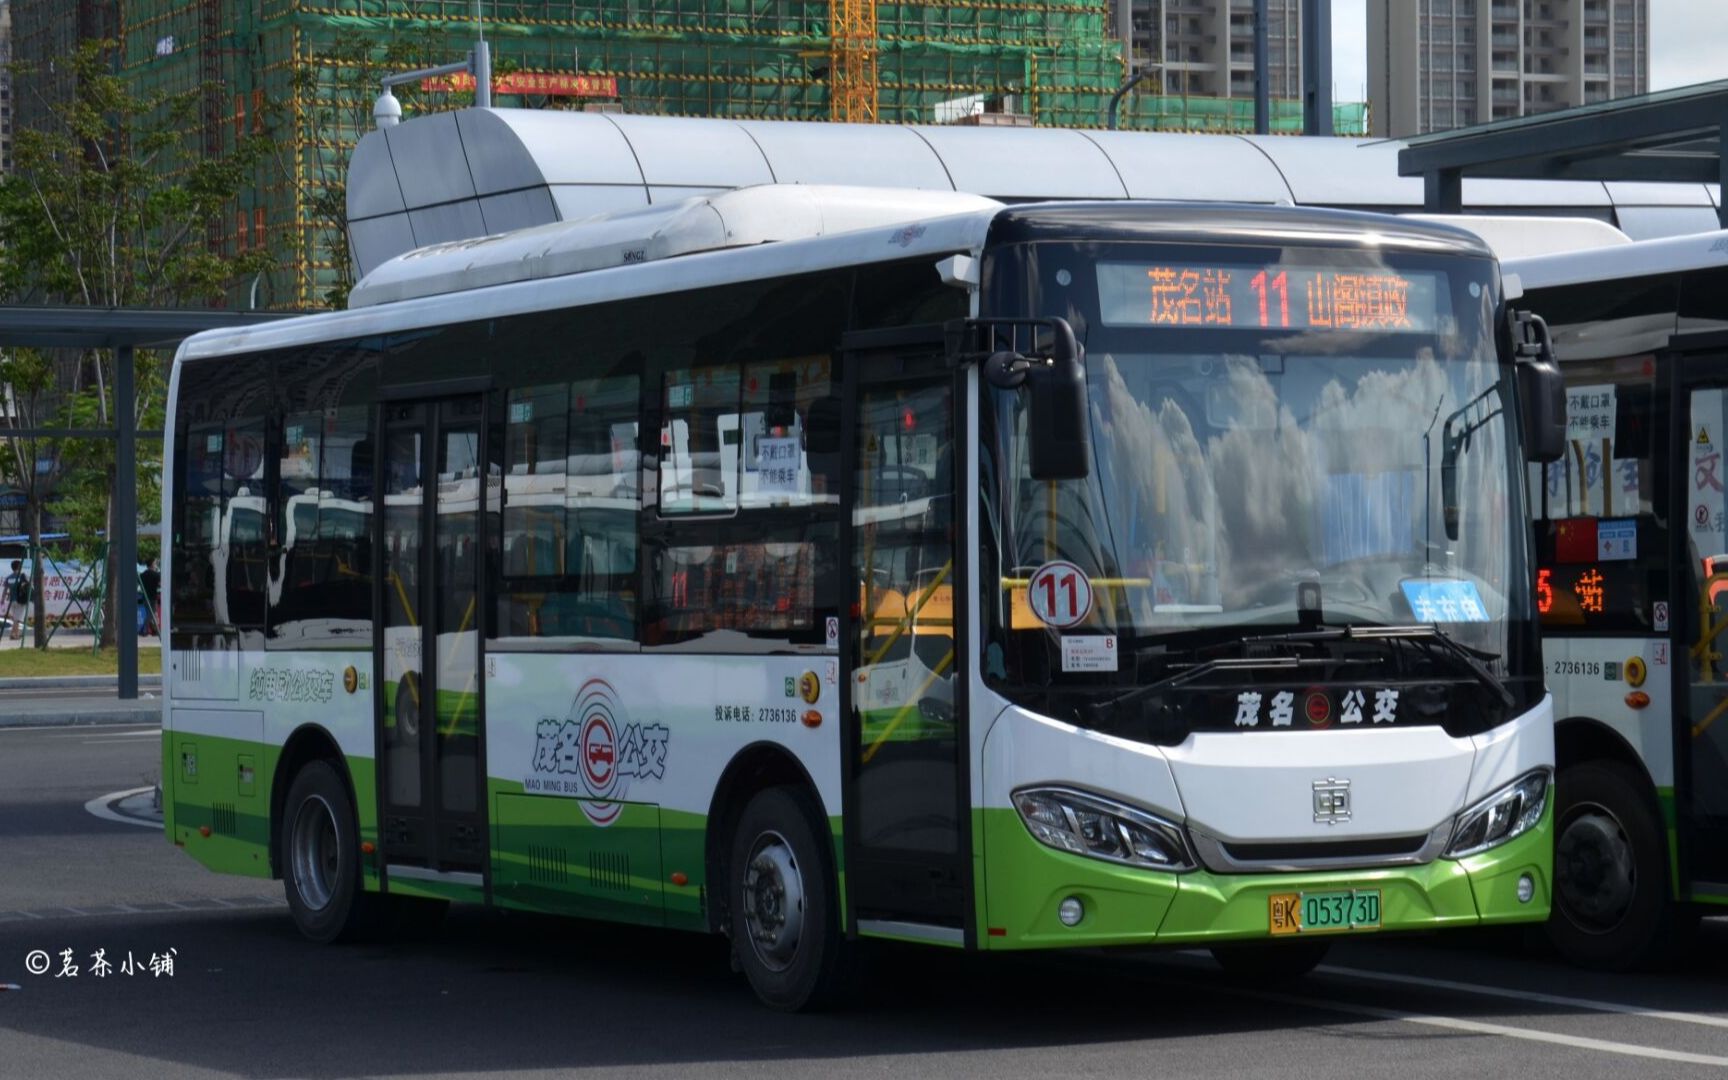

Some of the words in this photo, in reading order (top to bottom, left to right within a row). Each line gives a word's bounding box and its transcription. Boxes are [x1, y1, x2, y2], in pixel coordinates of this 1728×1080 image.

[1148, 267, 1232, 325] 茂名站
[1250, 270, 1290, 327] 11
[1569, 394, 1610, 410] 不戴口罩
[1569, 415, 1610, 431] 不能乘车
[761, 467, 795, 484] 不能乘车
[1039, 573, 1077, 617] 11
[1575, 568, 1604, 612] 站
[1106, 639, 1114, 649] B
[1554, 660, 1600, 676] 2736136
[249, 667, 334, 703] 纯电动公交车
[759, 708, 797, 723] 2736136
[1234, 690, 1295, 727] 茂名
[1340, 689, 1400, 724] 公交
[532, 719, 582, 775] 茂名
[617, 722, 670, 780] 公交
[524, 778, 541, 791] MAO
[543, 780, 562, 792] MING
[563, 781, 578, 793] BUS
[1307, 895, 1379, 926] 05373D
